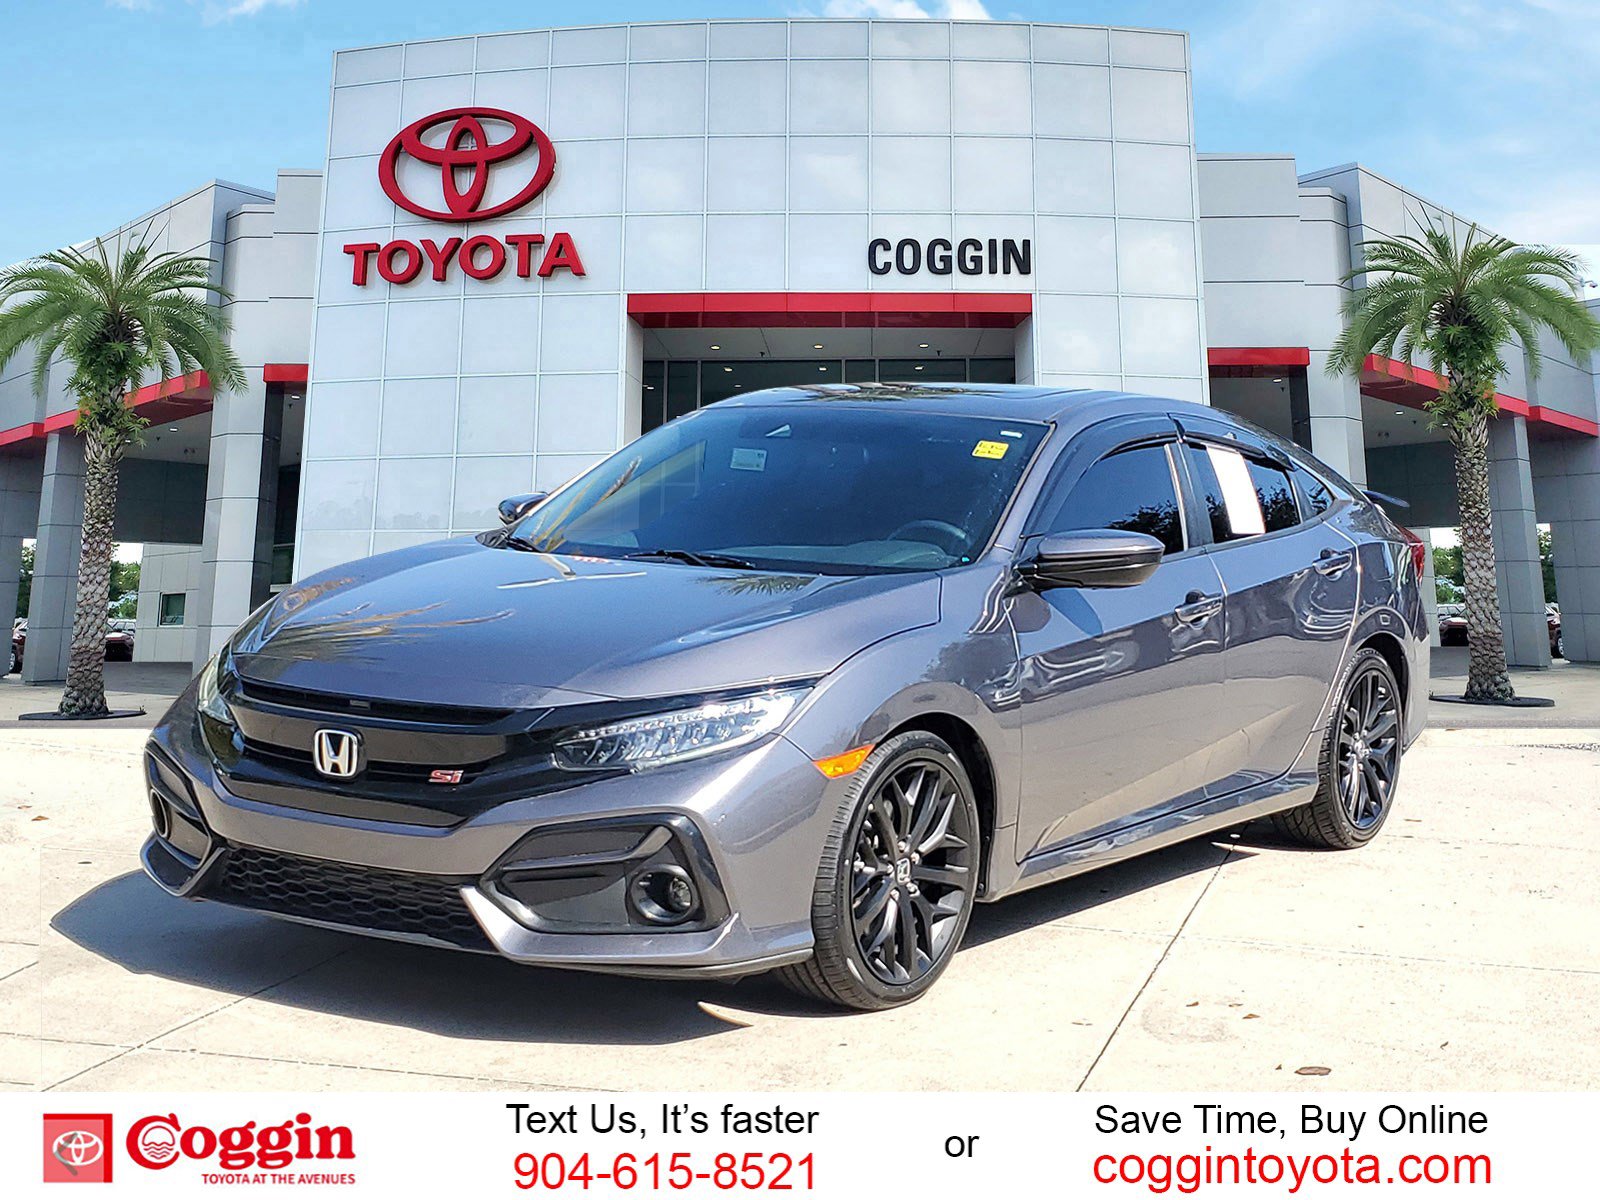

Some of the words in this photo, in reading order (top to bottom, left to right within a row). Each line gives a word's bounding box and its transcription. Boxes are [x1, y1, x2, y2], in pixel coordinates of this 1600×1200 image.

[343, 232, 586, 286] TOYOTA
[868, 238, 1032, 275] COGGIN
[428, 769, 464, 784] Si
